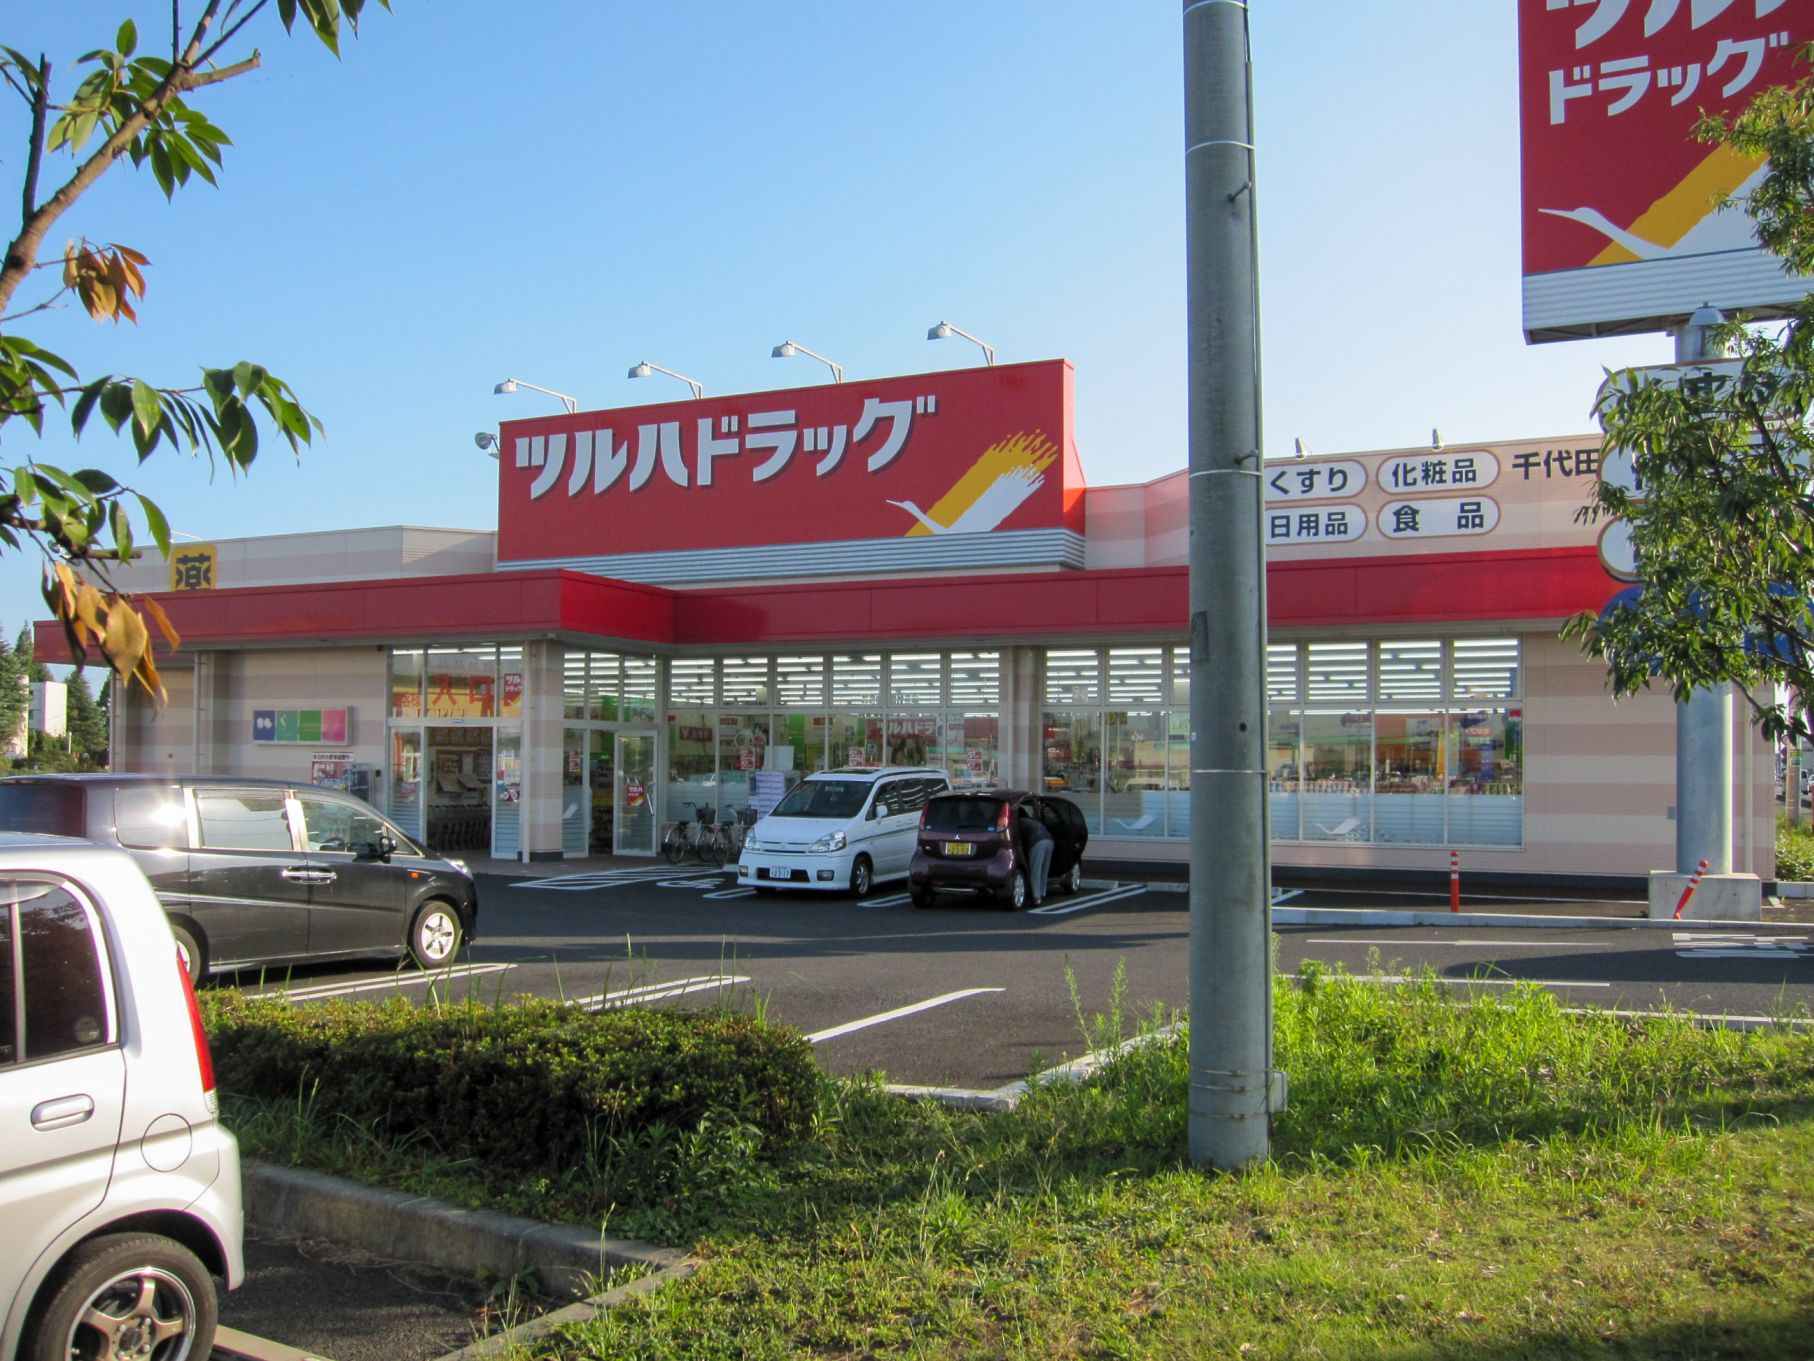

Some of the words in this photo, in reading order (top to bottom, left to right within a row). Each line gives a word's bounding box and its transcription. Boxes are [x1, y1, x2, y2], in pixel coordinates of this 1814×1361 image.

[1547, 30, 1790, 126] ドラッグ
[515, 393, 937, 500] ツルハドラッグ
[1270, 467, 1350, 494] くすり
[1391, 457, 1477, 488] 化粧品
[1270, 511, 1349, 538] 日用品
